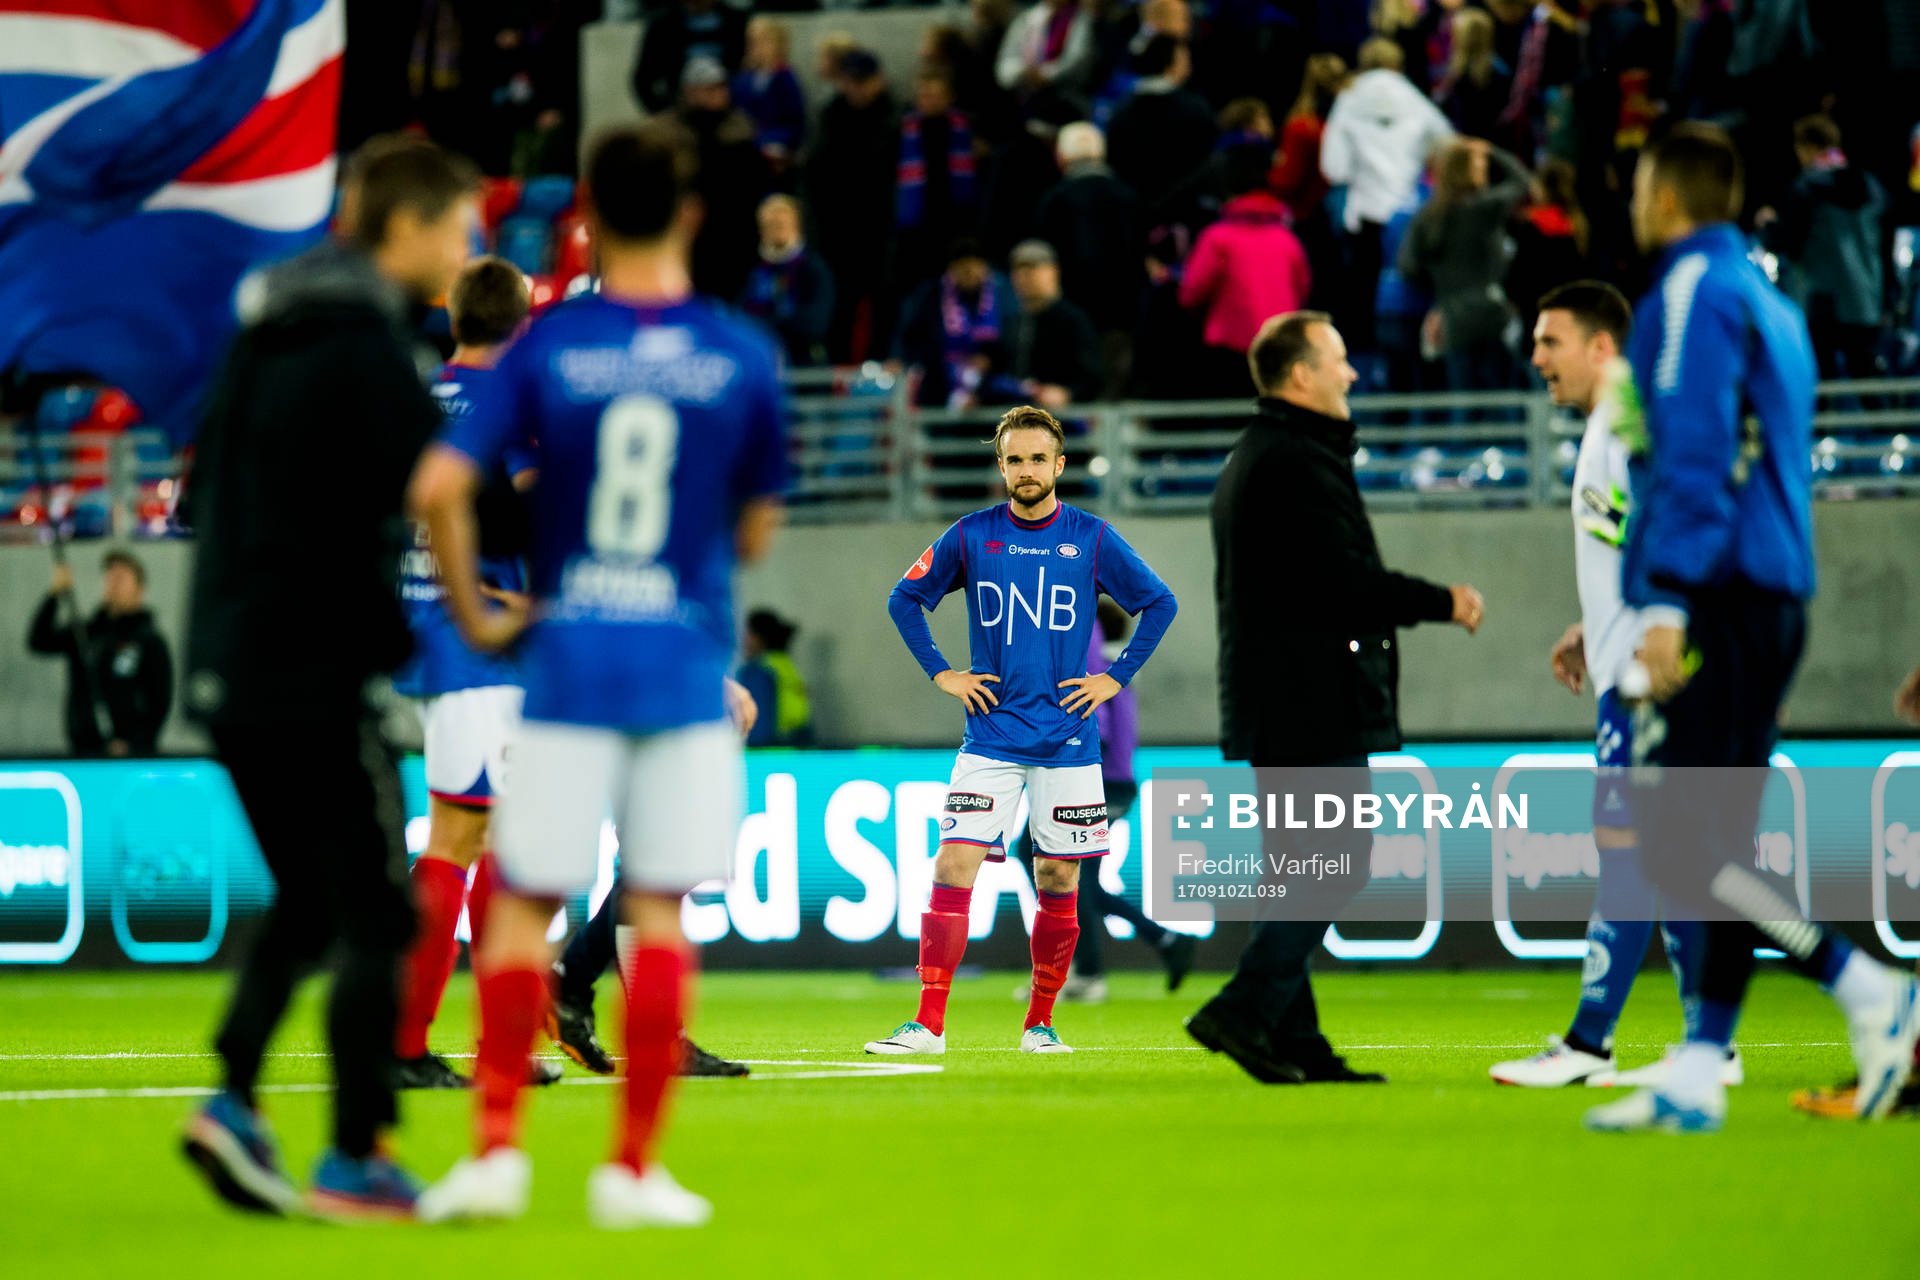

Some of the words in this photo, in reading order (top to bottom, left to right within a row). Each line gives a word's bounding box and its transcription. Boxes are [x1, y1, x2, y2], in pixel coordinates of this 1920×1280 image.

[589, 394, 680, 554] 8
[1017, 546, 1050, 556] Fjordkraft
[976, 566, 1077, 646] DNB
[946, 795, 990, 809] USEGARD
[1070, 830, 1088, 844] 15
